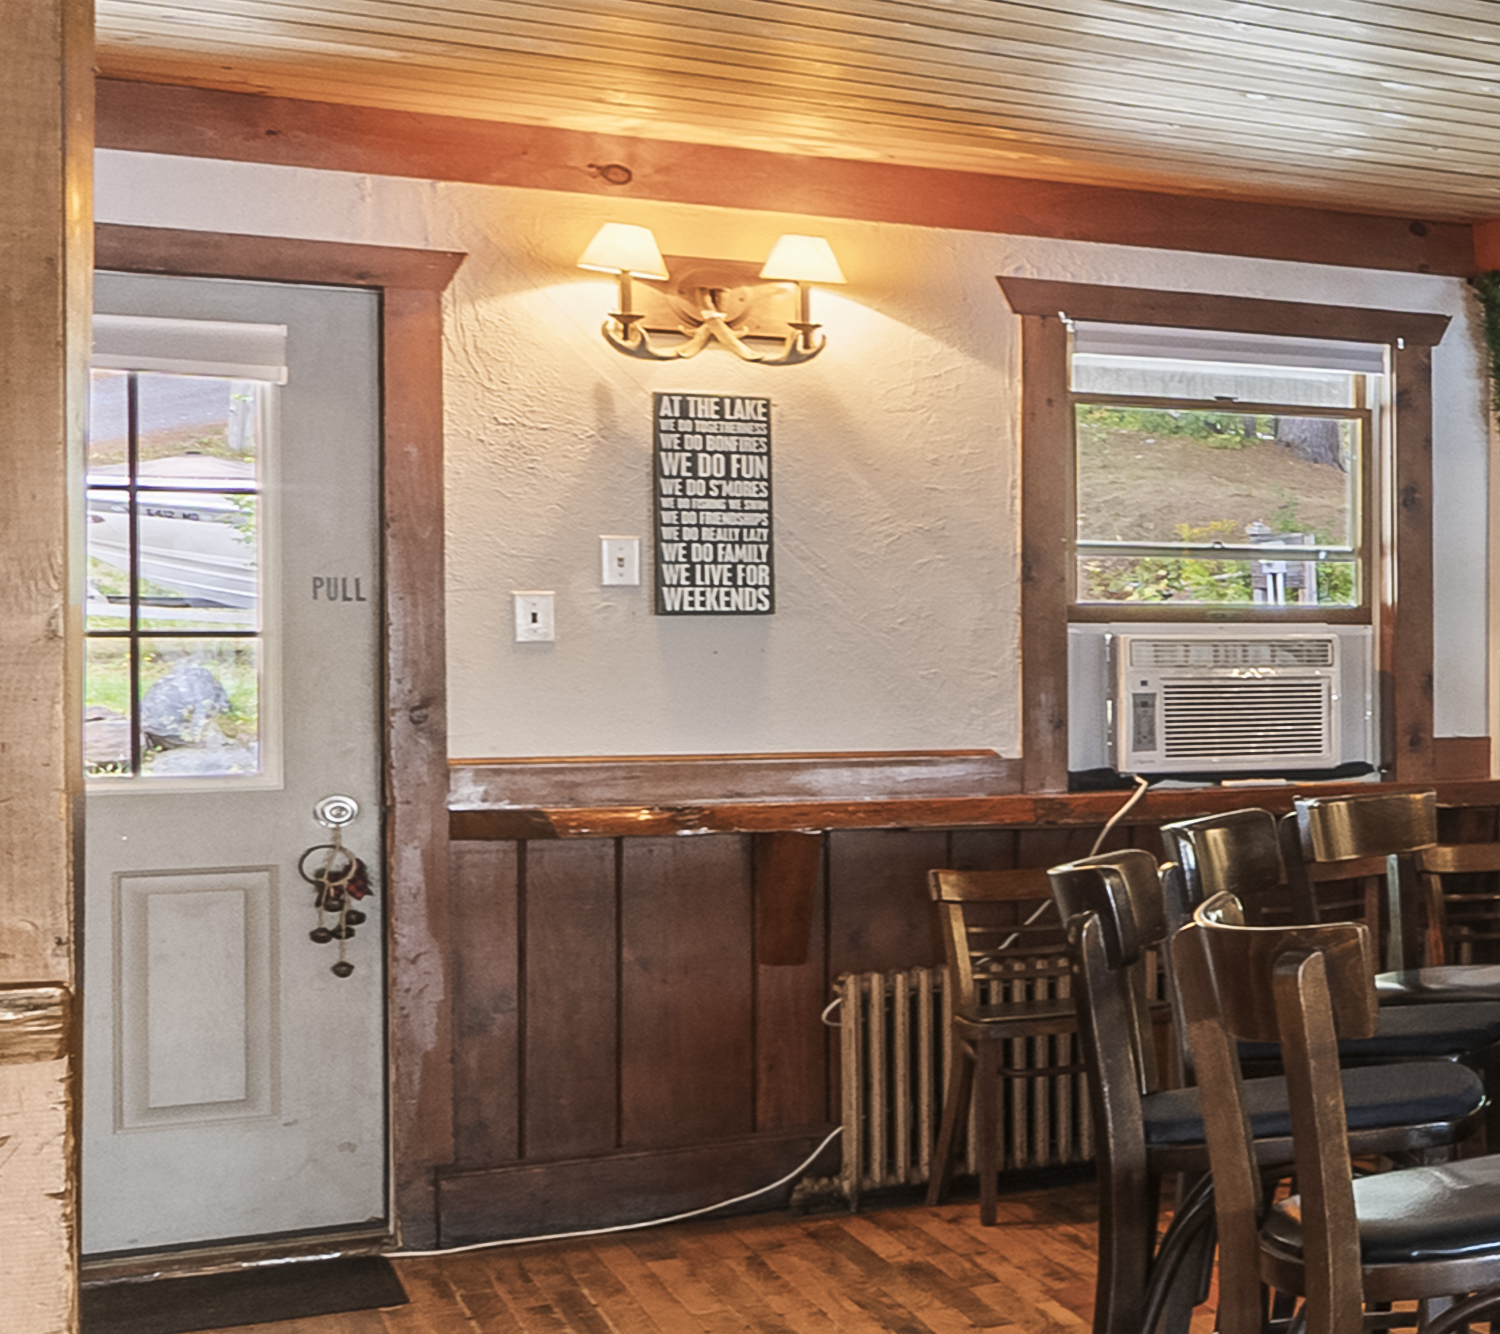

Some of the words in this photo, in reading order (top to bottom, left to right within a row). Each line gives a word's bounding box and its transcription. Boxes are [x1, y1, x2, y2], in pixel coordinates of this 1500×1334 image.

[659, 395, 682, 417] AT
[686, 396, 721, 419] THE
[724, 398, 768, 421] LAKE
[659, 419, 676, 431] WE
[677, 419, 693, 432] DO
[659, 433, 682, 450] WE
[683, 434, 703, 451] DO
[705, 435, 768, 453] BONFIRES
[660, 452, 693, 477] WE
[697, 453, 726, 478] DO
[730, 455, 769, 479] FUN
[660, 478, 683, 495] WE
[685, 479, 706, 496] DO
[708, 479, 769, 498] S'MORES
[660, 511, 679, 524] WE
[681, 511, 697, 525] DO
[660, 526, 680, 540] WE
[682, 527, 699, 541] DO
[701, 527, 741, 542] REALLY
[742, 528, 769, 542] LAZY
[661, 543, 688, 562] WE
[691, 543, 714, 563] DO
[717, 543, 769, 563] FAMILY
[661, 563, 691, 585] WE
[695, 564, 734, 585] LIVE
[737, 564, 770, 586] FOR
[312, 575, 367, 603] PULL
[662, 586, 770, 612] WEEKENDS
